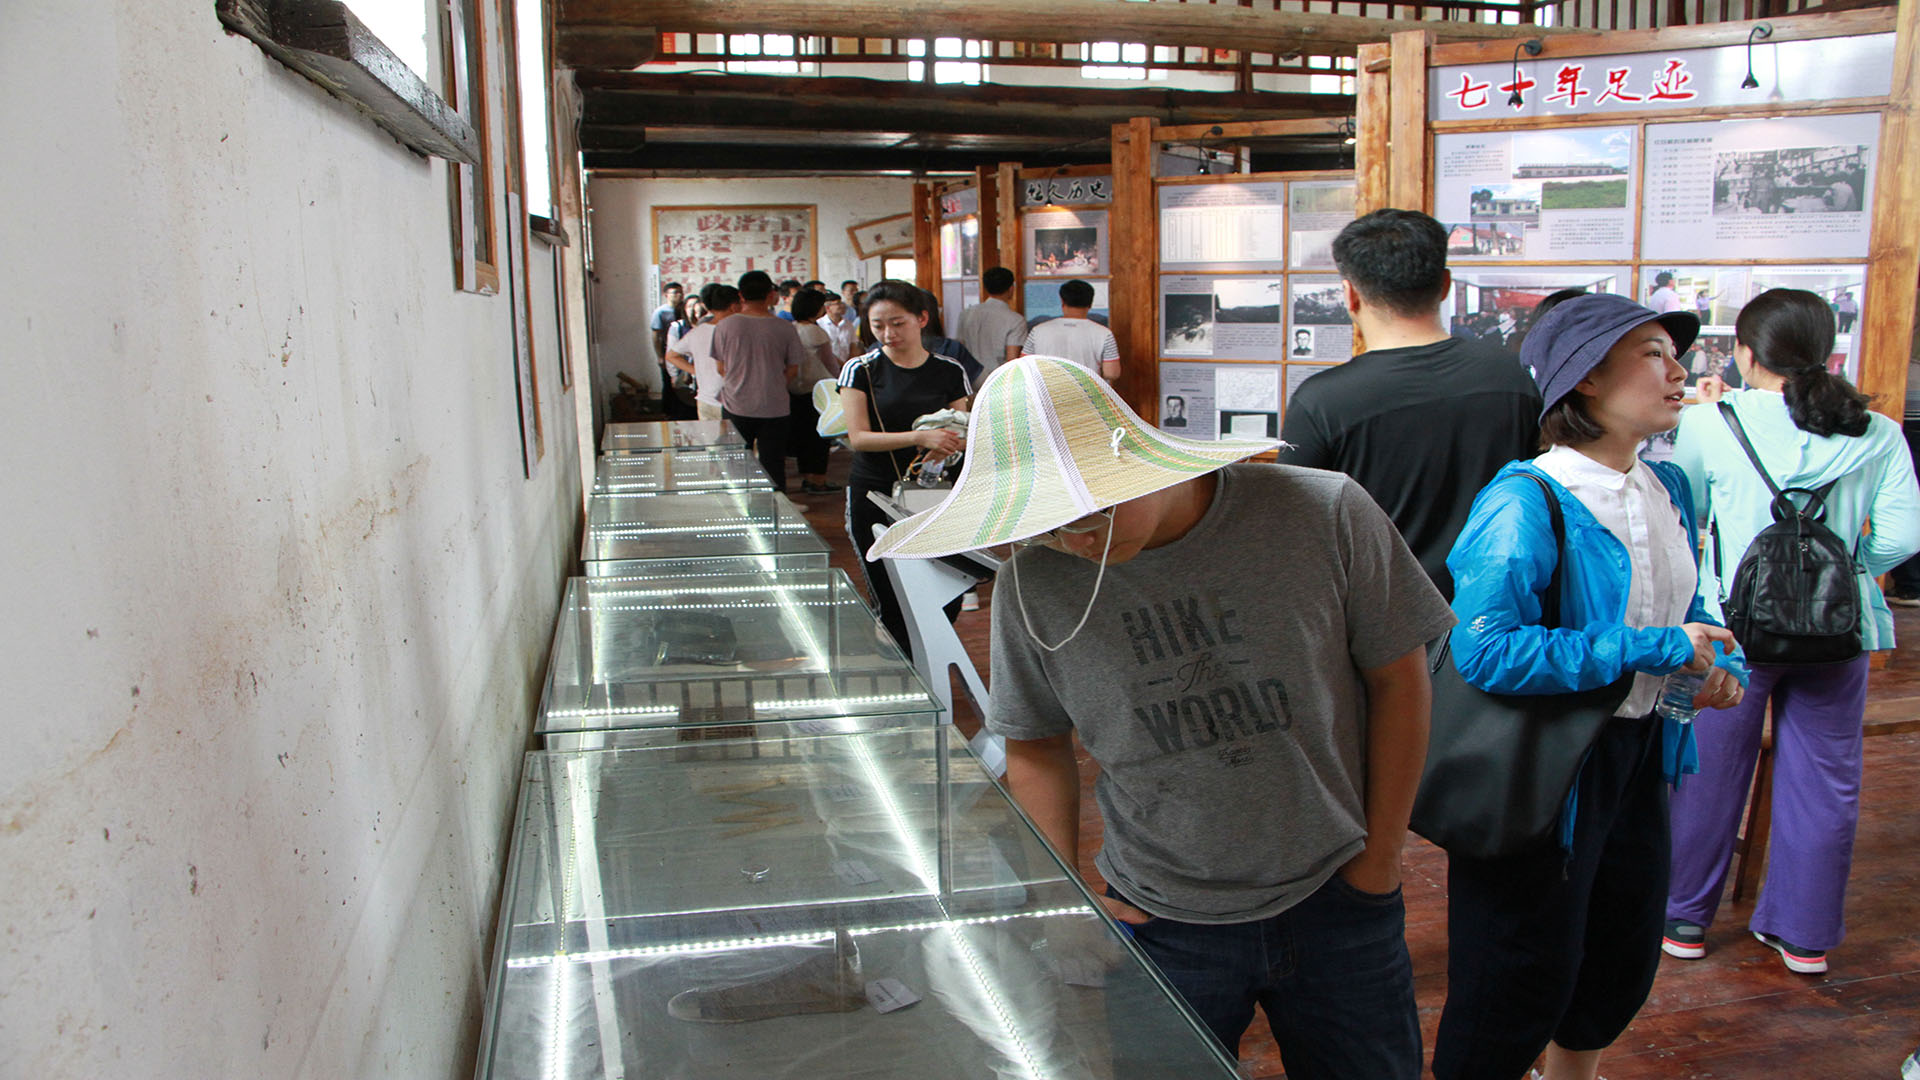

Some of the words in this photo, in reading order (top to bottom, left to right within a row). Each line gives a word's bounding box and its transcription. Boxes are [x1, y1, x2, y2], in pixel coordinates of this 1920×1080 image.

[1447, 60, 1696, 109] 七十年足迹
[1121, 596, 1243, 666] HIKE
[1177, 652, 1229, 692] The
[1134, 678, 1292, 754] WORLD
